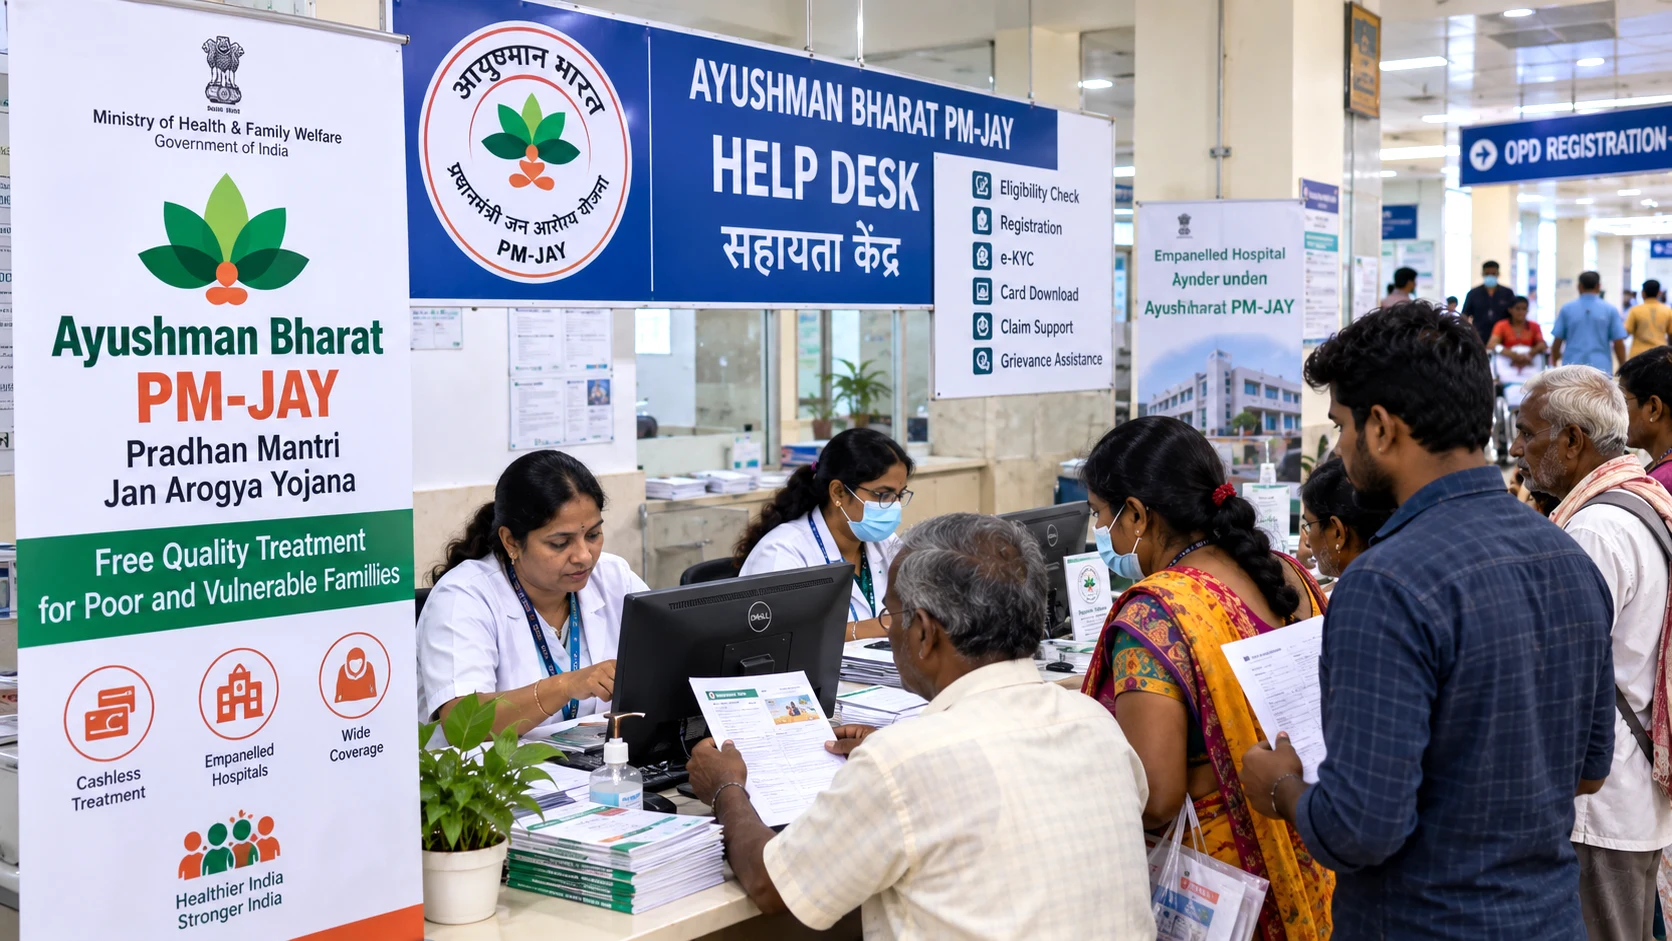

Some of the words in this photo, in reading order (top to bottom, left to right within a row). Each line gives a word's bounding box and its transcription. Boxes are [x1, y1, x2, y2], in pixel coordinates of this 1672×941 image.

[555, 55, 606, 115] भारत
[690, 58, 842, 122] AYUSHMAN
[852, 87, 938, 137] BHARAT
[946, 105, 1013, 149] PM-JAY
[94, 109, 154, 131] Ministry
[160, 116, 174, 129] of
[180, 117, 225, 133] Health
[231, 121, 241, 134] &
[247, 122, 290, 142] Family
[295, 127, 341, 144] Welfare
[155, 134, 238, 153] Government
[242, 142, 254, 153] of
[259, 143, 288, 156] India
[1505, 139, 1541, 164] OPD
[1547, 126, 1666, 160] REGISTRATION
[713, 135, 817, 200] HELP
[832, 150, 919, 211] DESK
[1001, 180, 1047, 203] Eligibility
[1051, 185, 1080, 204] Check
[505, 216, 529, 234] जन
[1001, 215, 1062, 235] Registration
[497, 239, 565, 264] PM-JAY
[721, 226, 843, 276] सहायता
[853, 220, 901, 277] केंद्र
[1001, 251, 1033, 266] e-KYC
[1155, 248, 1227, 264] Empanelled
[1233, 248, 1285, 263] Hospital
[1223, 271, 1267, 285] unden
[1001, 285, 1025, 299] Card
[1030, 286, 1078, 301] Download
[1232, 299, 1294, 314] PM-JAY
[1001, 319, 1030, 334] Claim
[1035, 320, 1073, 337] Support
[52, 316, 257, 367] Ayushman
[271, 317, 383, 354] Bharat
[1001, 353, 1051, 368] Grievance
[1055, 352, 1102, 366] Assistance
[138, 370, 339, 423] PM-JAY
[128, 437, 247, 467] Pradhan
[258, 432, 339, 461] Mantri
[105, 480, 155, 507] Jan
[166, 476, 262, 507] Arogya
[271, 469, 355, 502] Yojana
[96, 548, 153, 576] Free
[163, 538, 249, 571] Quality
[256, 529, 366, 560] Treatment
[38, 596, 75, 624] for
[85, 592, 143, 619] Poor
[152, 582, 195, 611] and
[203, 571, 317, 604] Vulnerable
[325, 563, 399, 591] Famillies
[342, 726, 370, 741] Wide
[206, 743, 274, 768] Empanelled
[330, 744, 383, 761] Coverage
[77, 768, 141, 790] Cashless
[213, 764, 268, 786] Hospitals
[72, 786, 145, 811] Treatment
[177, 882, 244, 909] Healthier
[250, 872, 283, 894] India
[179, 903, 243, 929] Stronger
[249, 892, 281, 911] India
